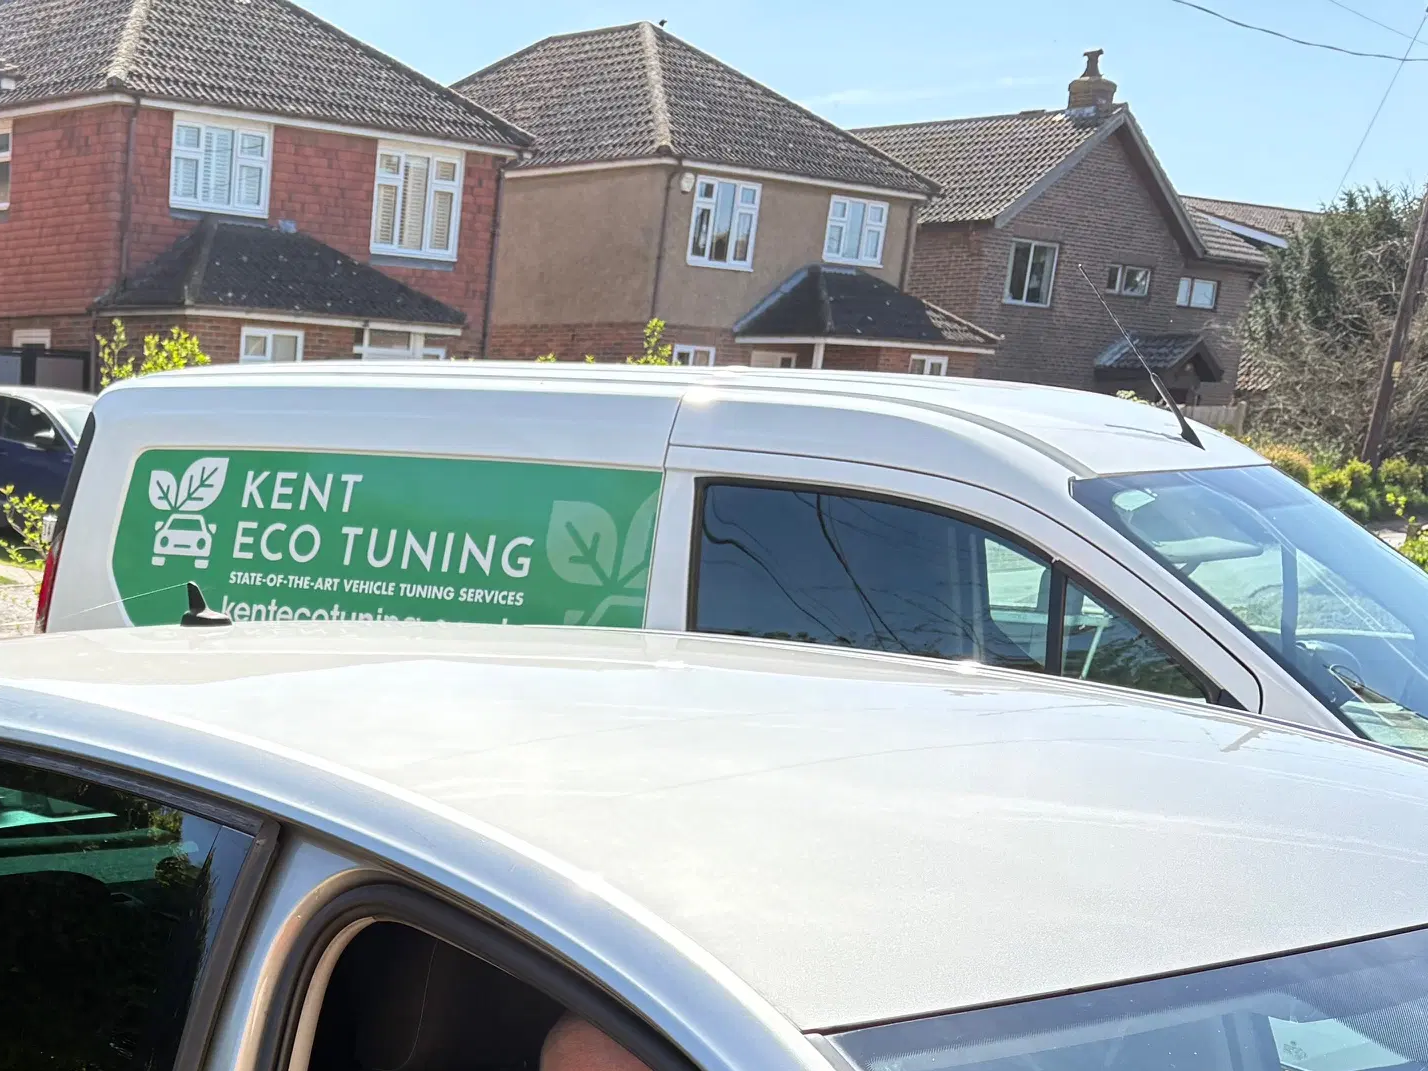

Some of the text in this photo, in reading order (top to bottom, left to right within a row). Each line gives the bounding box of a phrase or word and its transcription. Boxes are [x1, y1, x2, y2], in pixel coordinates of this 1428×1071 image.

[241, 470, 363, 513] KENT
[233, 521, 535, 578] ECO TUNING
[229, 571, 524, 606] STATE-OF-THE-ART VEHICLE TUNING SERVICES
